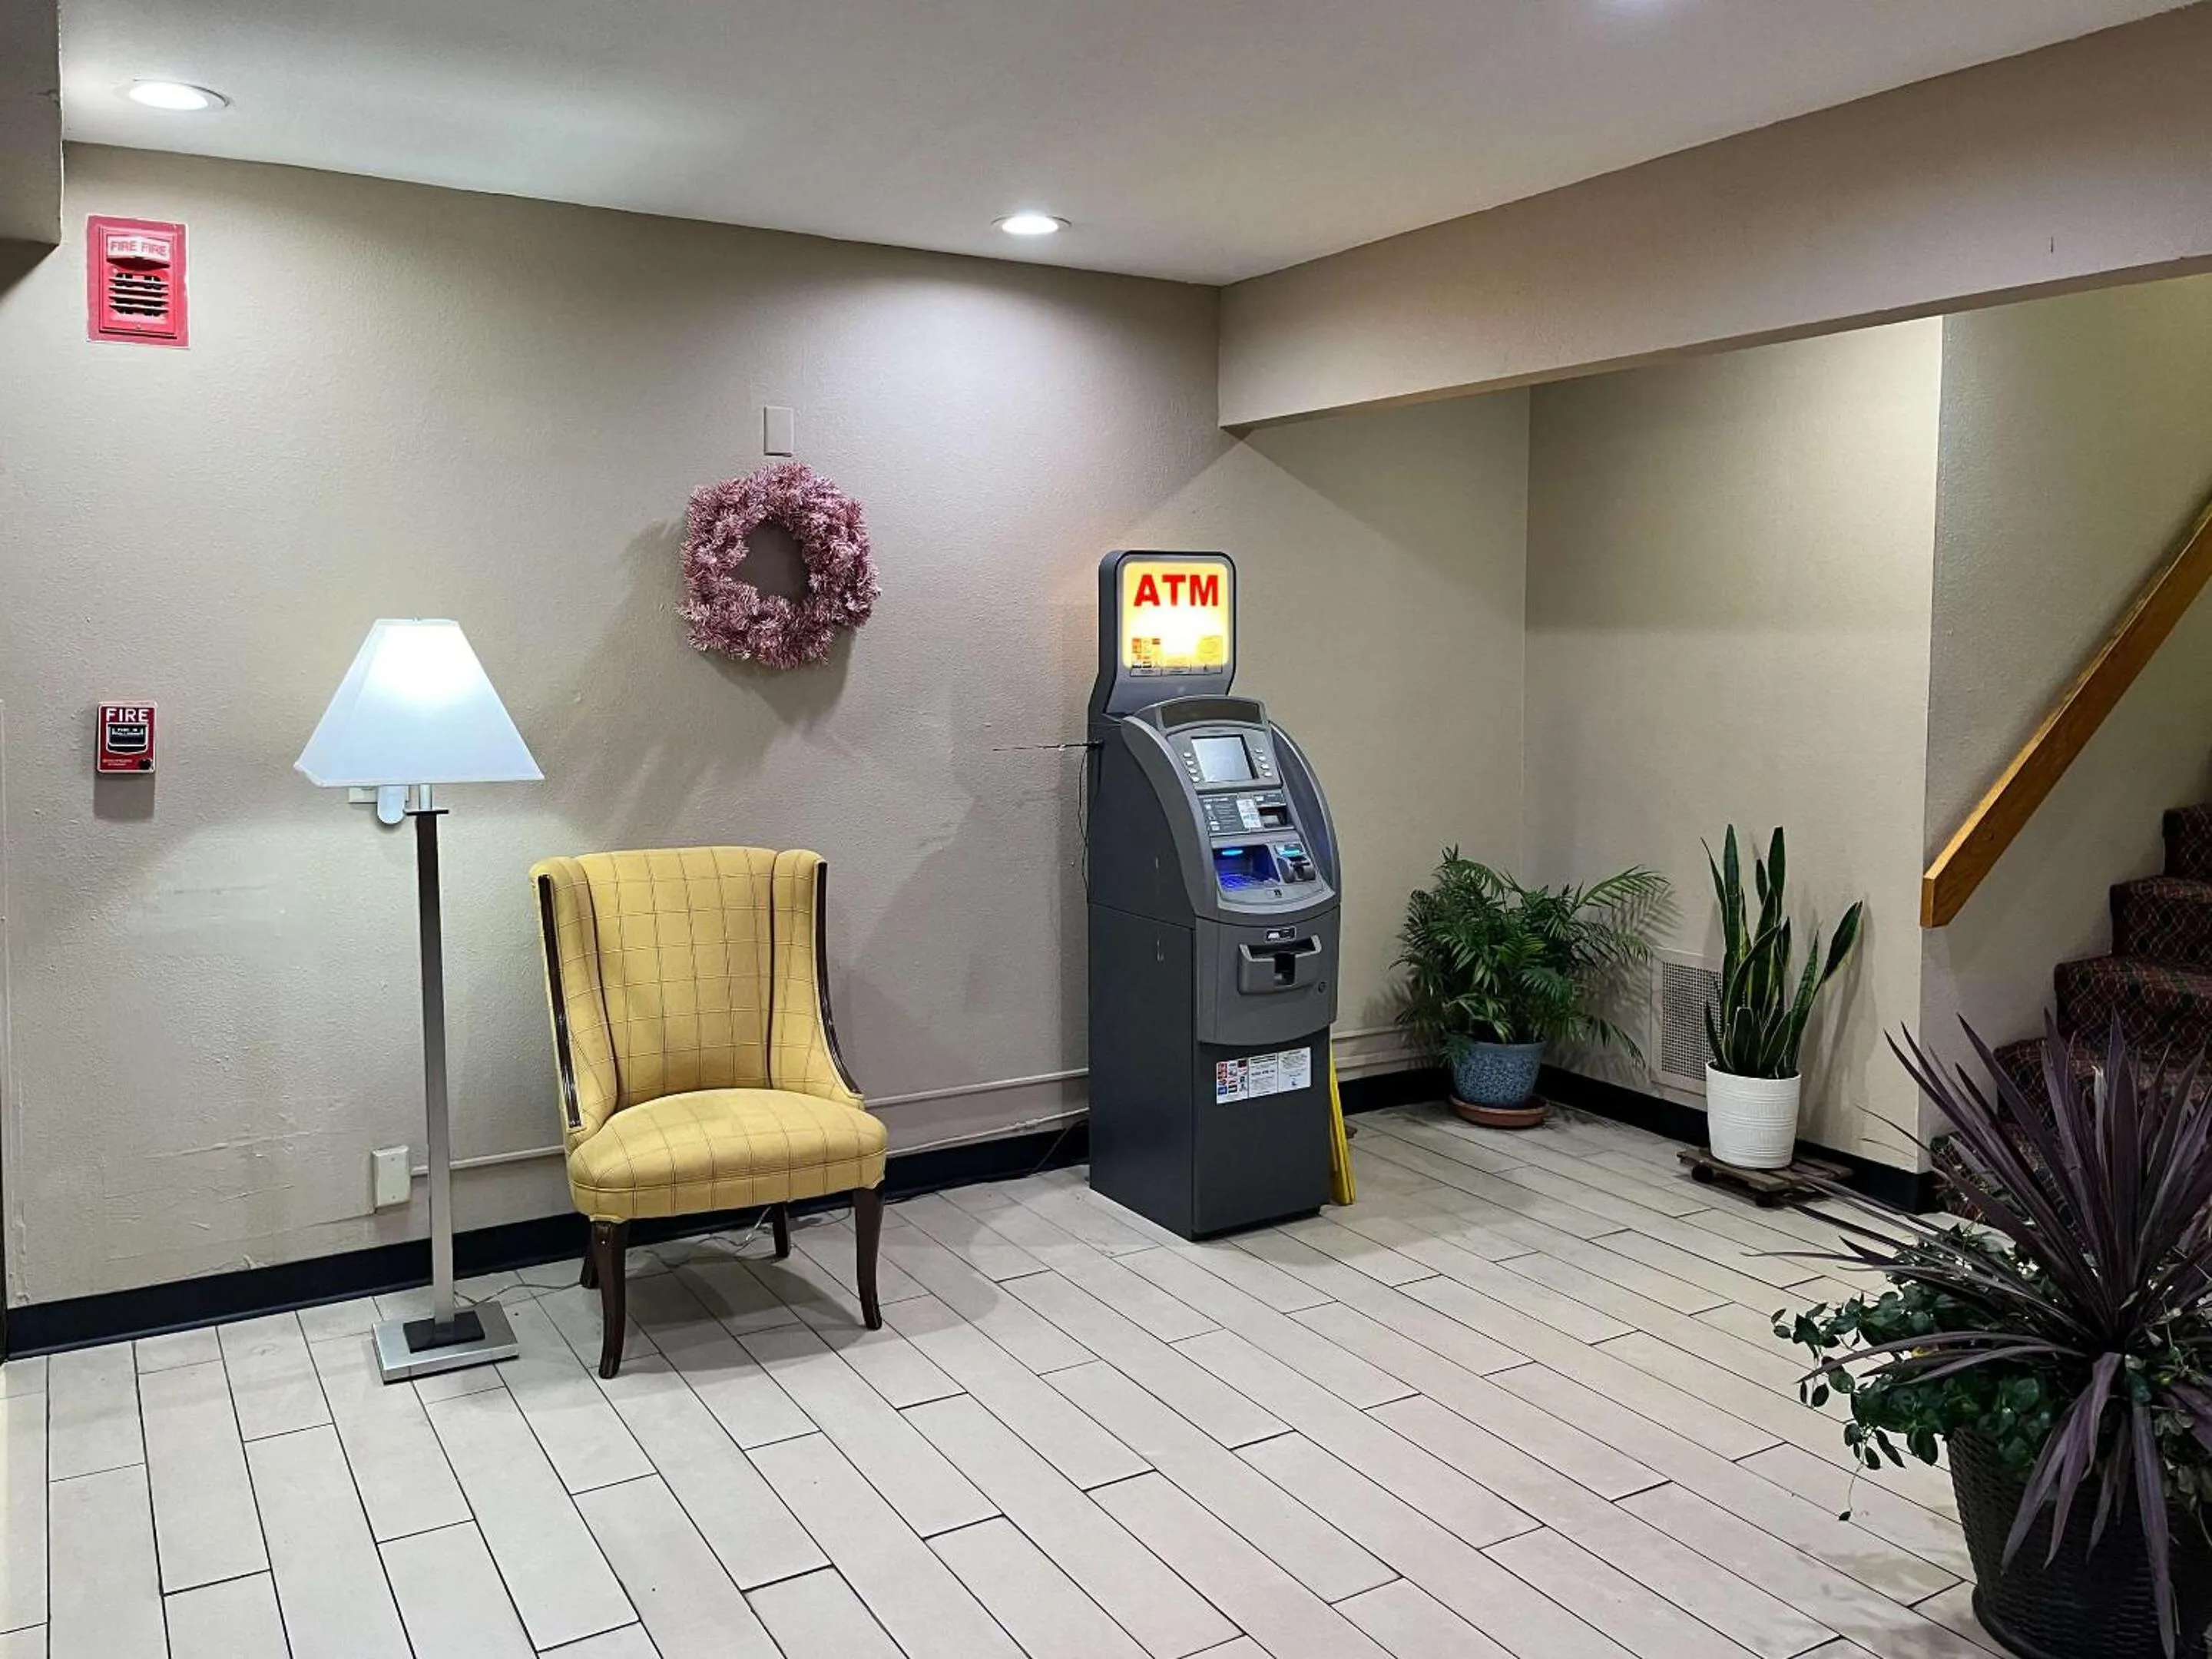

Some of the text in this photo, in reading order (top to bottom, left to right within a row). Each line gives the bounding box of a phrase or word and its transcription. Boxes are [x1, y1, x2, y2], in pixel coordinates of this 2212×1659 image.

[110, 240, 167, 257] FIRE FIRE
[1134, 574, 1219, 607] ATM
[106, 708, 149, 722] FIRE
